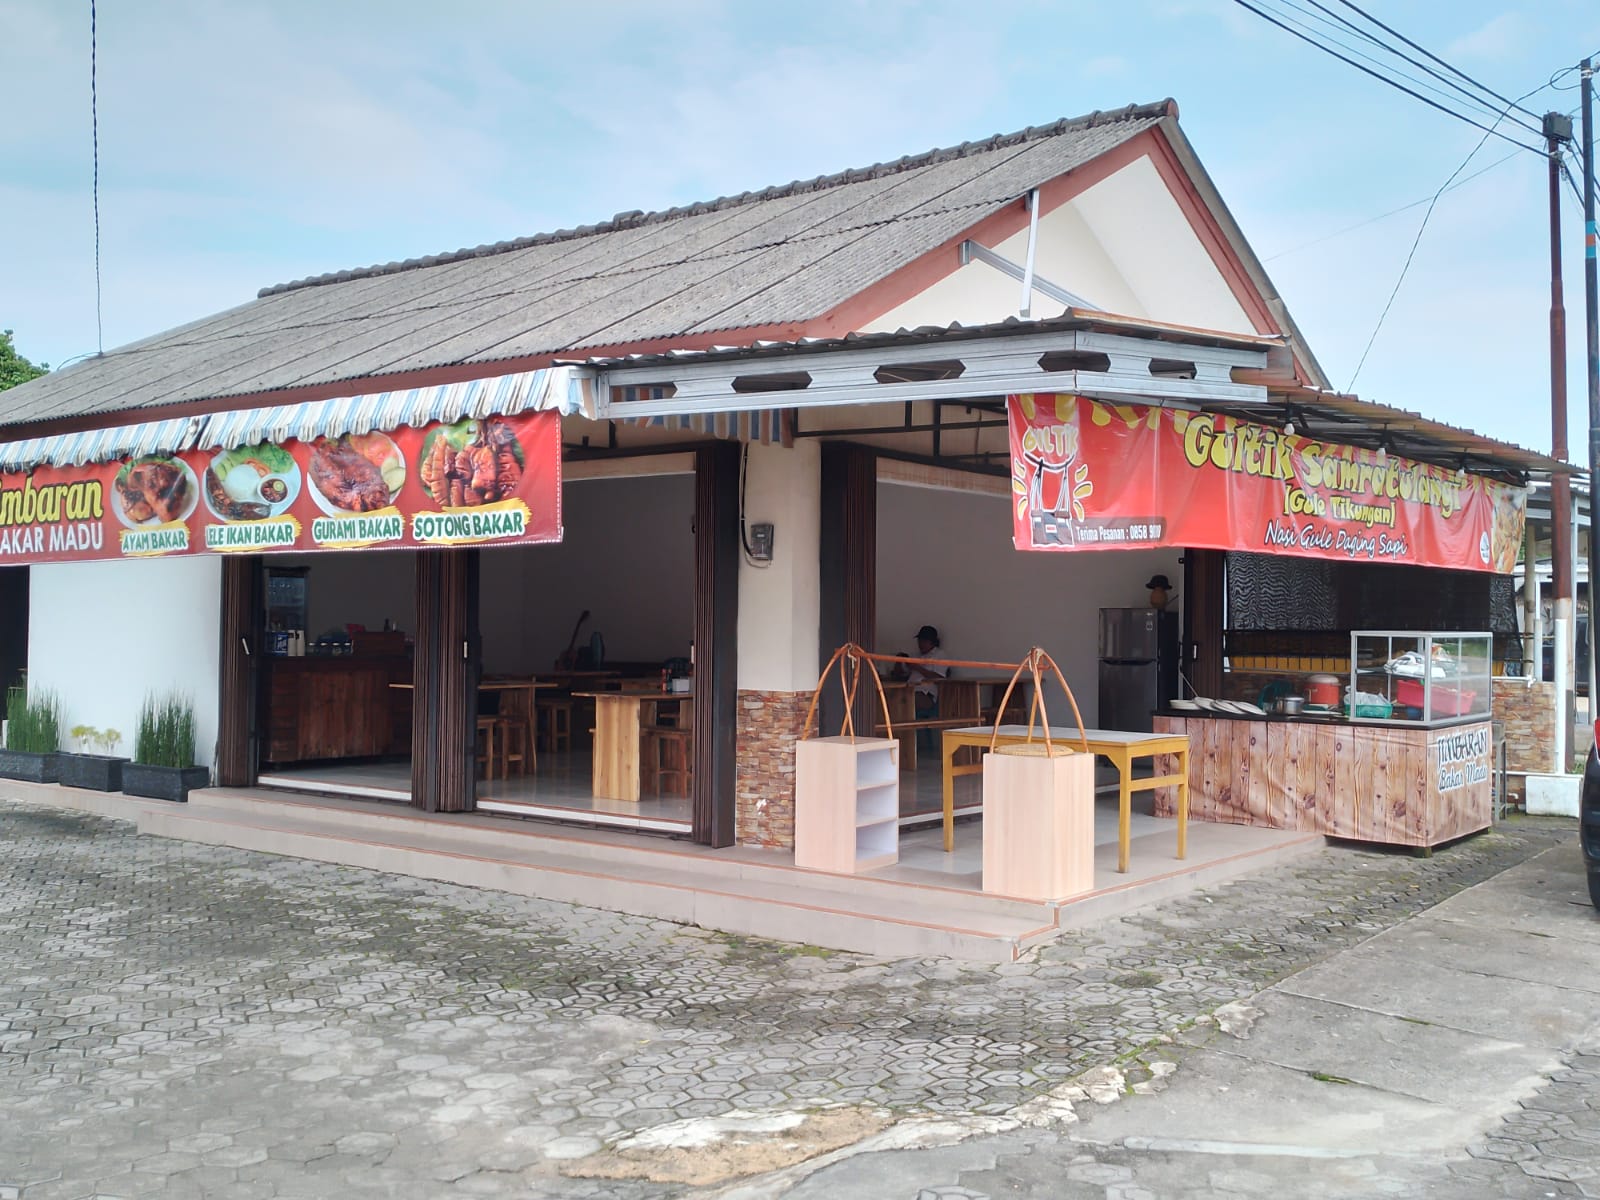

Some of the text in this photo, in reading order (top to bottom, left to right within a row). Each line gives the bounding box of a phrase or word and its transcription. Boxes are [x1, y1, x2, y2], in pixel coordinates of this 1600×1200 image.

[1184, 413, 1295, 480] Gultik
[1301, 443, 1462, 518] Samratulangi
[48, 522, 102, 552] MADU
[226, 525, 252, 545] IKAN
[254, 524, 293, 544] BAKAR
[314, 517, 400, 541] GURAMI BAKAR
[414, 511, 523, 538] SOTONG BAKAR
[1076, 525, 1098, 540] Terima
[1099, 525, 1125, 540] Pesanan
[123, 530, 187, 550] AYAM BAKAR
[1264, 519, 1408, 559] Nasi Gule Daging Sapi
